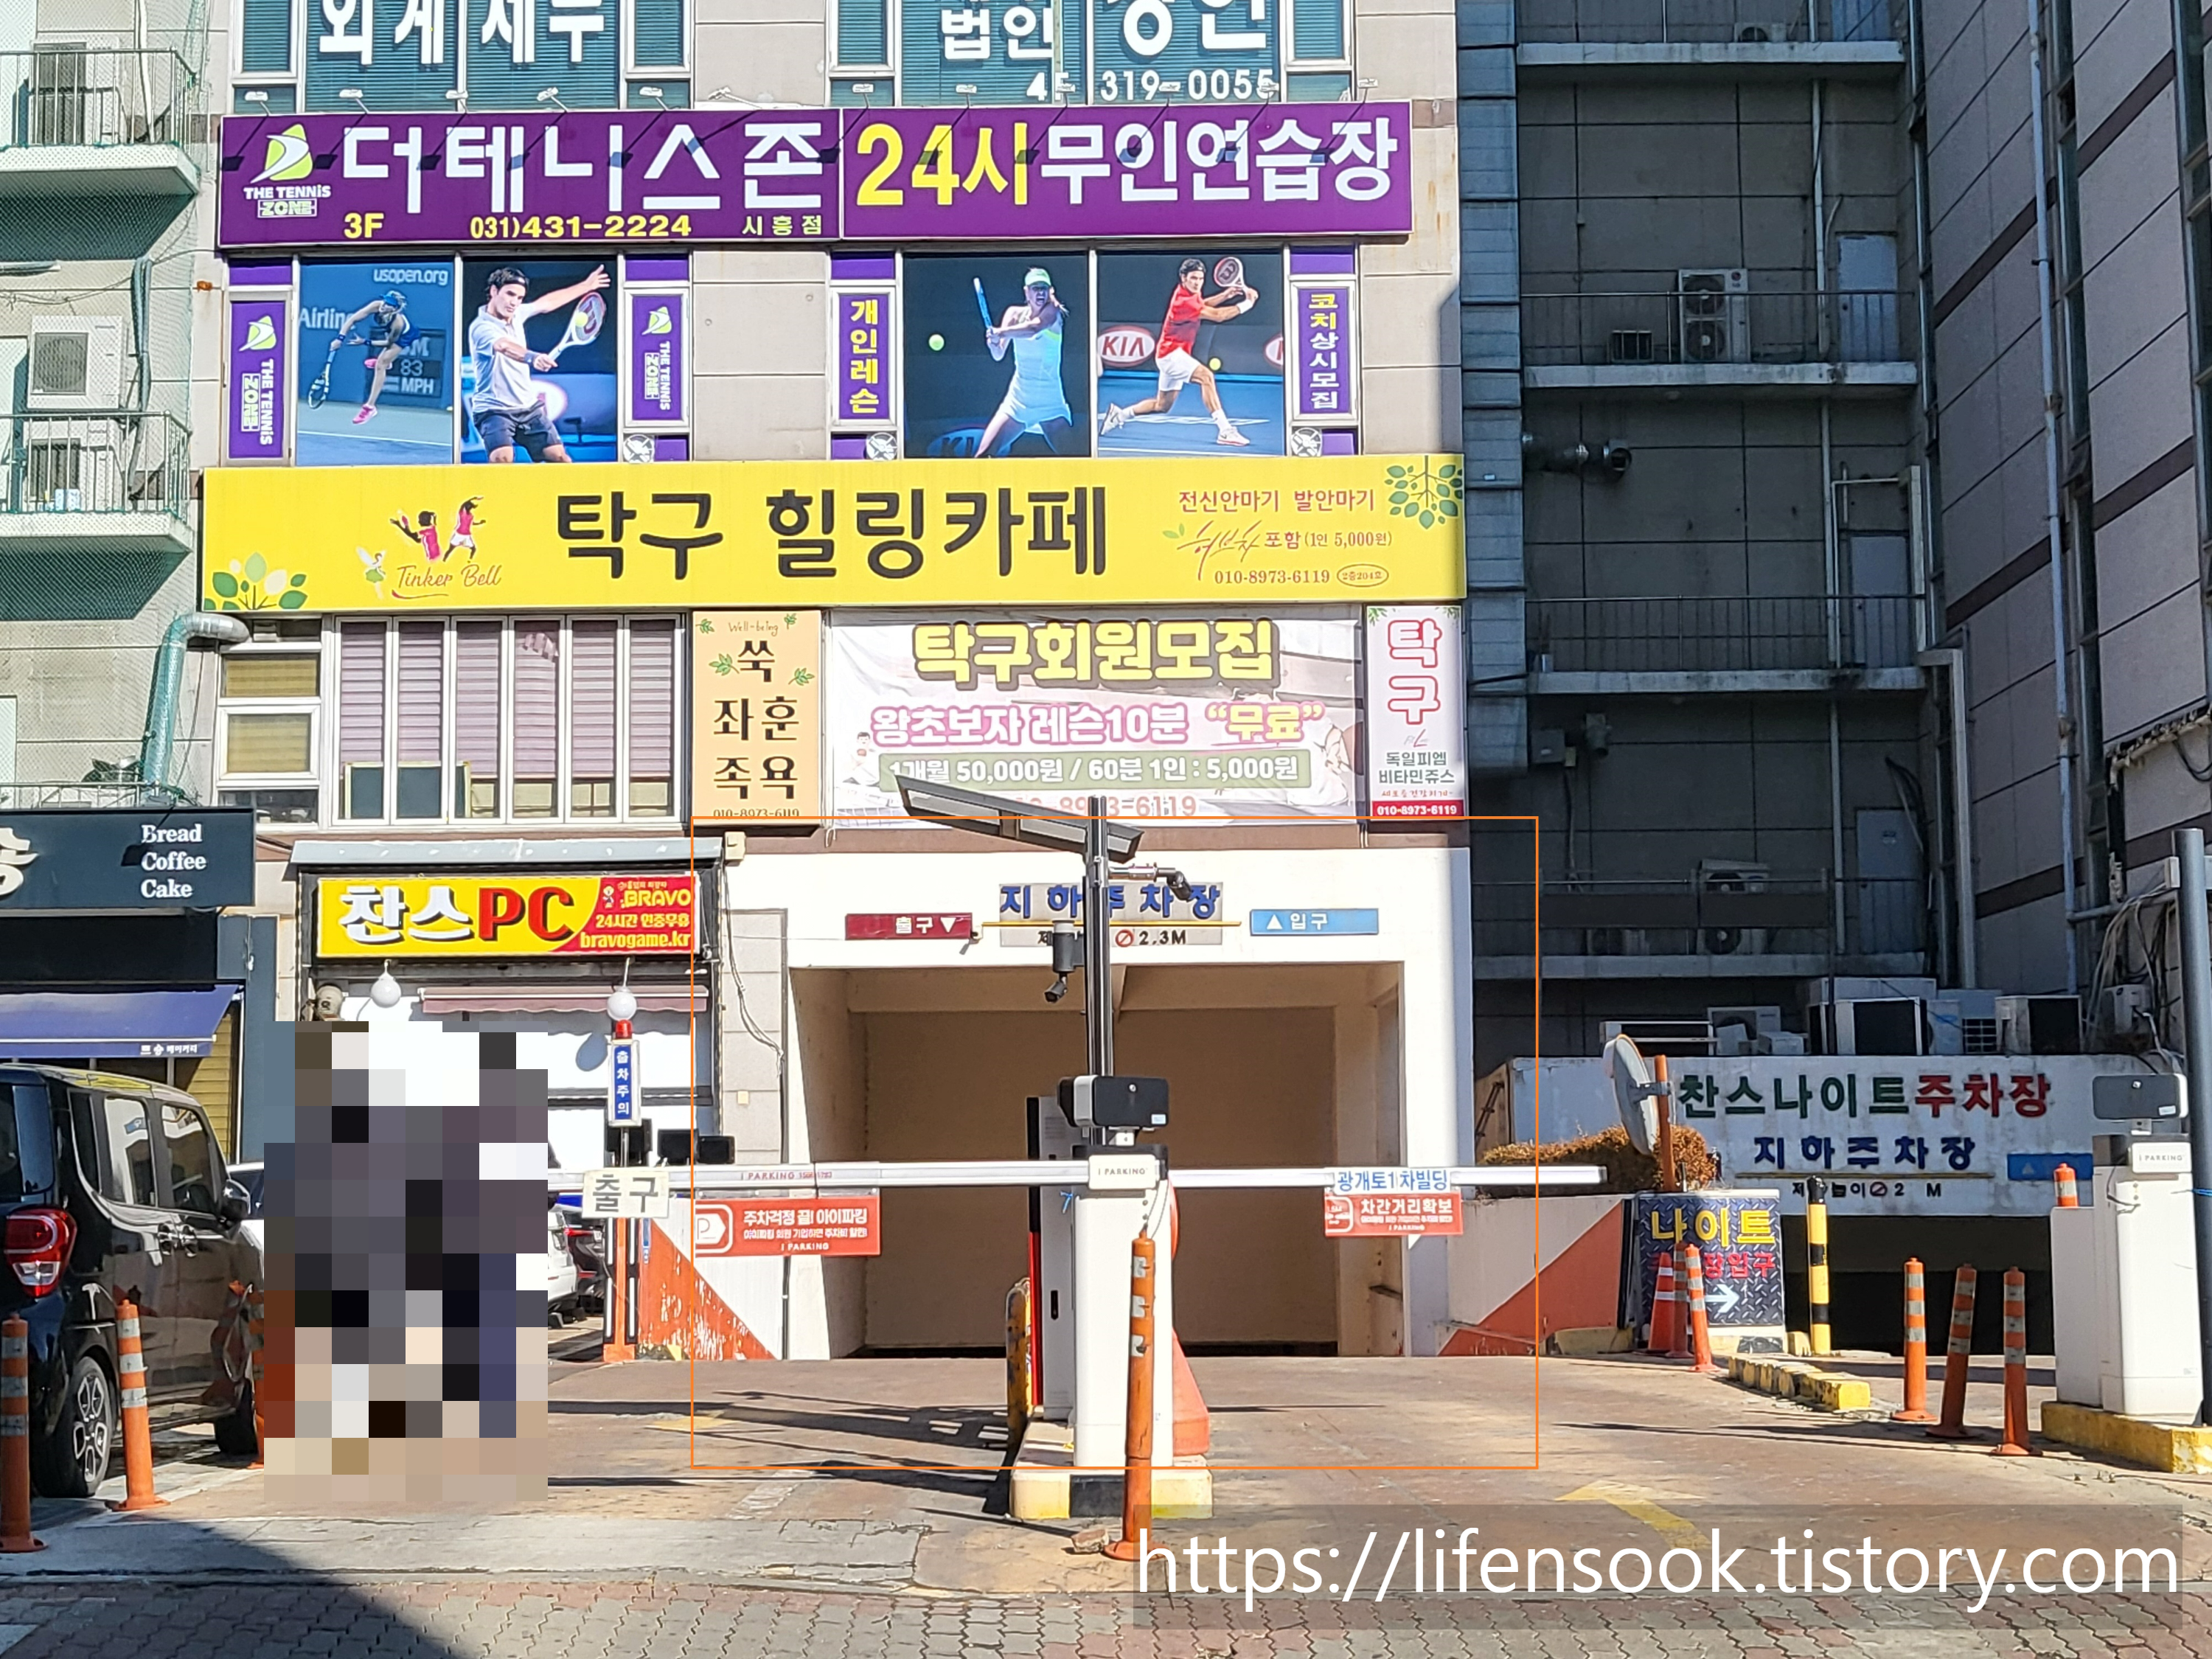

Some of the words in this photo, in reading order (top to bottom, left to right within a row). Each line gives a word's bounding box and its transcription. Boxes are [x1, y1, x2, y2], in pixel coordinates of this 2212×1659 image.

[343, 123, 822, 214] 더테니스존
[857, 122, 1028, 207] 24시
[1040, 118, 1398, 204] 무인연습장
[243, 187, 274, 200] THE
[262, 201, 313, 216] ZONE
[344, 213, 385, 238] 3F
[470, 215, 692, 238] 031)431-2224
[742, 215, 822, 236] 시흥점
[373, 268, 448, 285] usopen.org
[299, 307, 356, 330] Airlin
[849, 299, 880, 414] 개인레슨
[1102, 335, 1144, 357] KIA
[400, 359, 423, 377] 83
[401, 378, 434, 394] MPH
[1179, 490, 1279, 512] 전신안마기
[1294, 489, 1374, 512] 발안마기
[556, 491, 723, 580] 탁구
[765, 487, 1106, 579] 힐링카페
[1265, 532, 1301, 549] 포함
[397, 564, 453, 589] Tinker
[460, 563, 503, 587] Bell
[1214, 570, 1330, 585] 010-8973-6119
[737, 641, 775, 683] 쑥
[913, 619, 1280, 692] 탁구회원모집
[1388, 618, 1442, 725] 탁구
[714, 696, 799, 740] 좌훈
[1386, 752, 1447, 766] 독일피엠
[713, 756, 799, 800] 족욕
[956, 759, 1063, 784] 50,000원
[1088, 758, 1143, 782] 60분
[1149, 757, 1186, 782] 1인
[1206, 756, 1298, 782] 5,000원
[1379, 769, 1455, 784] 비타민쥬스
[1377, 805, 1457, 815] 010-8973-6119
[141, 824, 203, 843] Bread
[141, 852, 206, 871] Coffee
[140, 880, 192, 898] Cake
[623, 888, 692, 908] BRAVO
[339, 885, 575, 944] 찬스PC
[595, 914, 639, 928] 24시간
[894, 914, 934, 935] 출구
[1290, 911, 1328, 931] 입구
[580, 931, 692, 949] bravogame.kr
[1138, 929, 1186, 946] 2.3M
[616, 1050, 630, 1116] 출차주의
[1753, 1135, 1975, 1171] 지하주차장
[748, 1172, 795, 1180] PARKING
[592, 1174, 659, 1214] 출구
[1360, 1198, 1453, 1214] 차간거리확보
[743, 1209, 796, 1226] 주차걱정
[816, 1208, 868, 1224] 아이파킹
[1652, 1207, 1775, 1248] 나이트
[787, 1242, 829, 1251] PARKING
